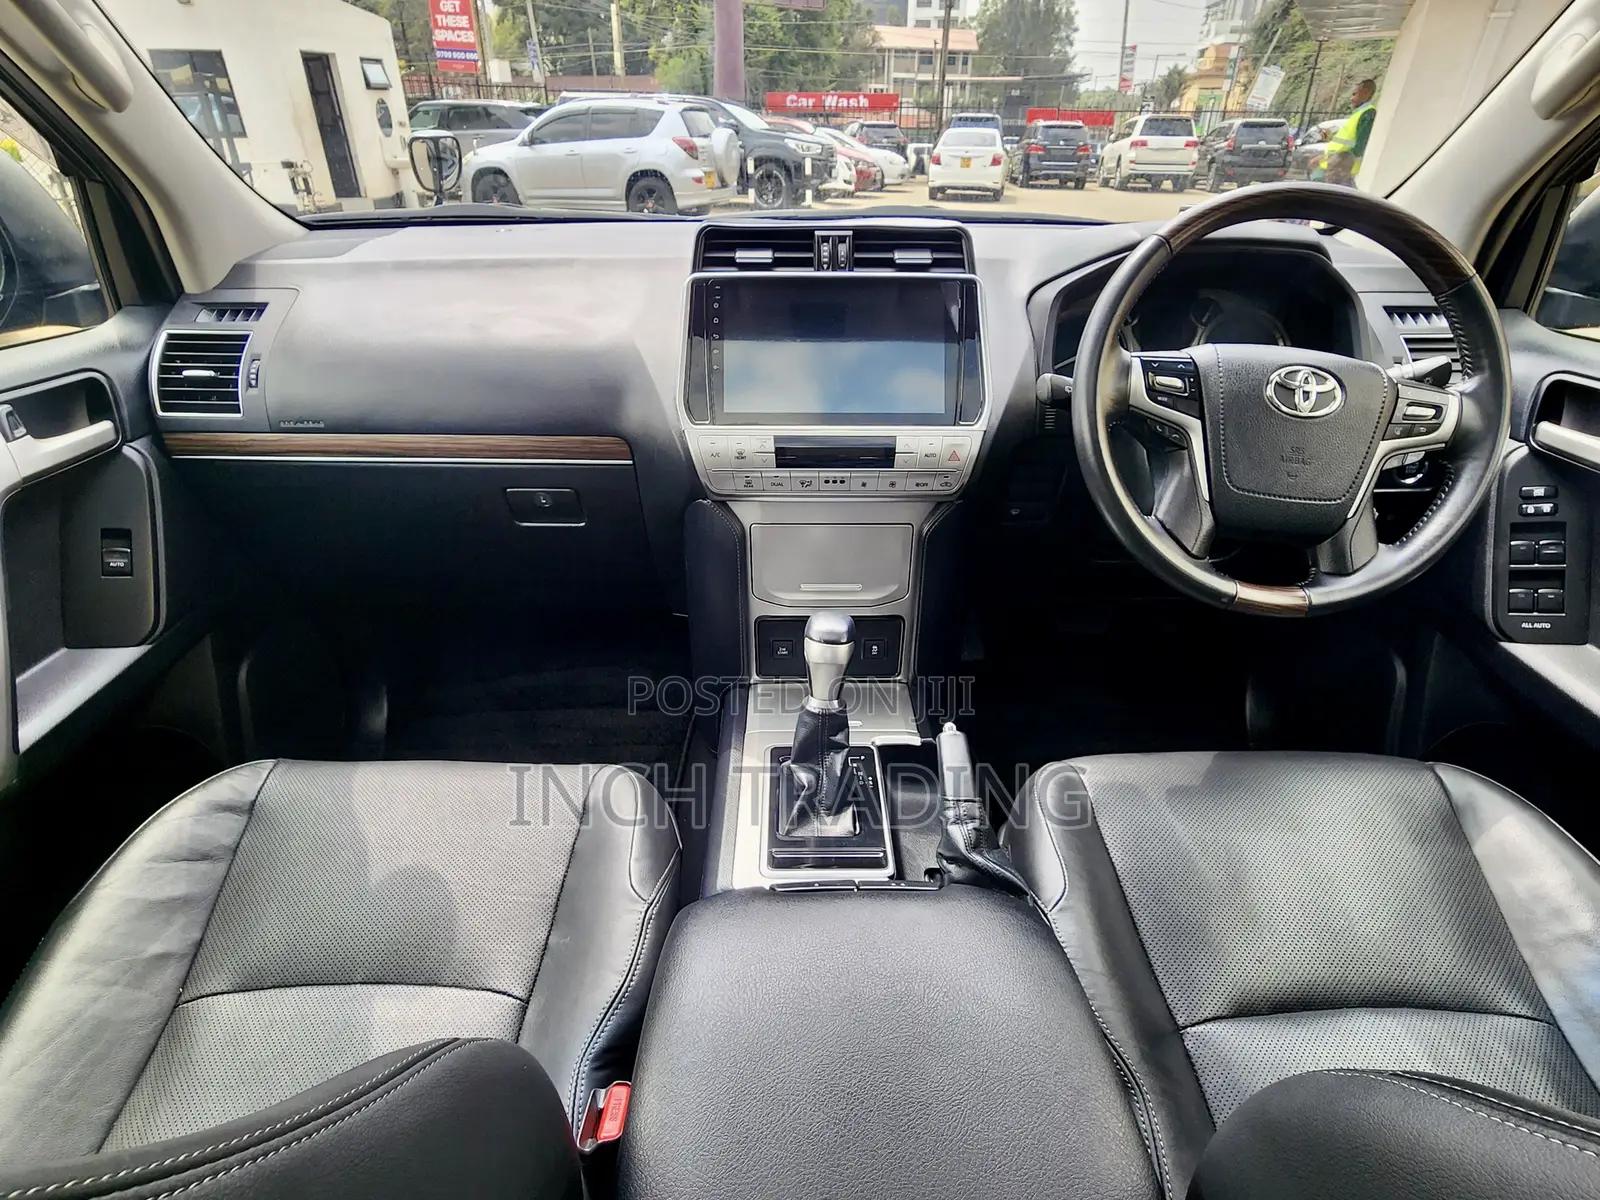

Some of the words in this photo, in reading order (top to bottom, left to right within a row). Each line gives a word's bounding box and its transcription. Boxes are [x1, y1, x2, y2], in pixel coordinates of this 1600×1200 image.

[440, 0, 461, 13] GET
[435, 14, 470, 28] THESE
[433, 29, 475, 43] SPACES
[785, 94, 816, 108] Car
[822, 95, 869, 110] Wash
